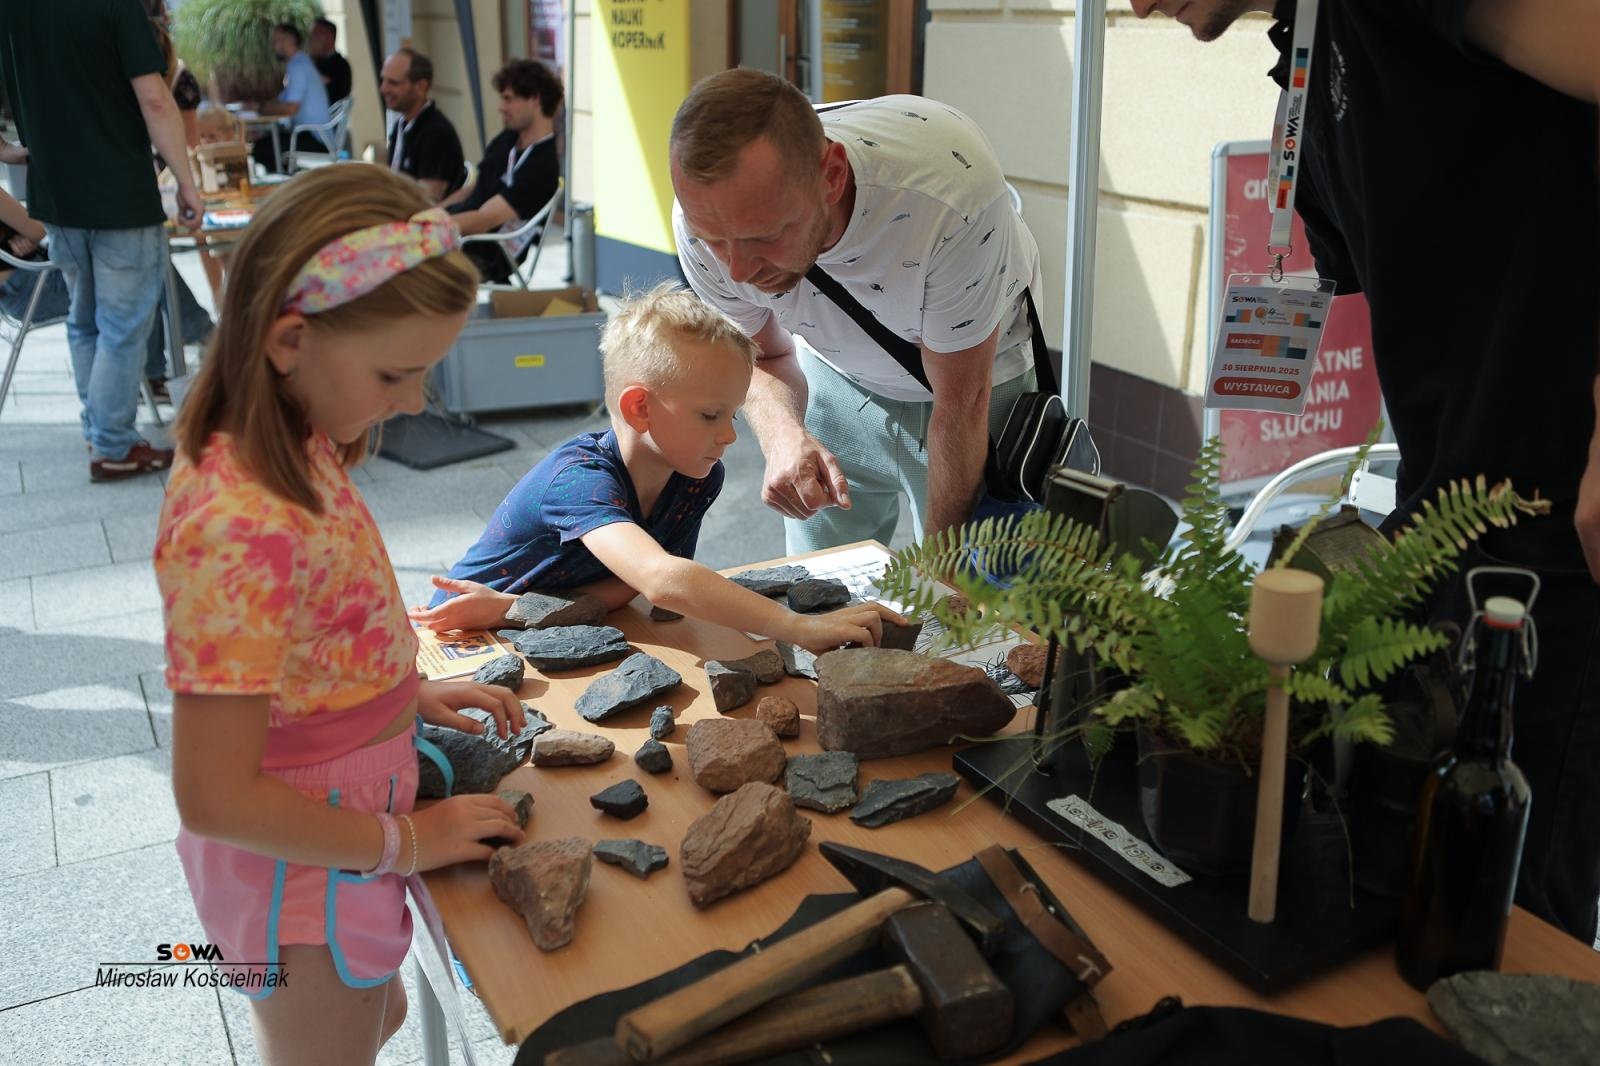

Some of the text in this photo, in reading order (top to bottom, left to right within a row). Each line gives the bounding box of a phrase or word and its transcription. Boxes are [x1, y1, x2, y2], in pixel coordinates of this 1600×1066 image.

[611, 8, 643, 25] NAUKI
[1283, 116, 1300, 161] SOWA
[1235, 364, 1276, 373] SIERPNIA
[1278, 367, 1300, 375] 2025
[1223, 382, 1290, 394] WYSTAWCA
[1260, 409, 1343, 442] SŁUCHU
